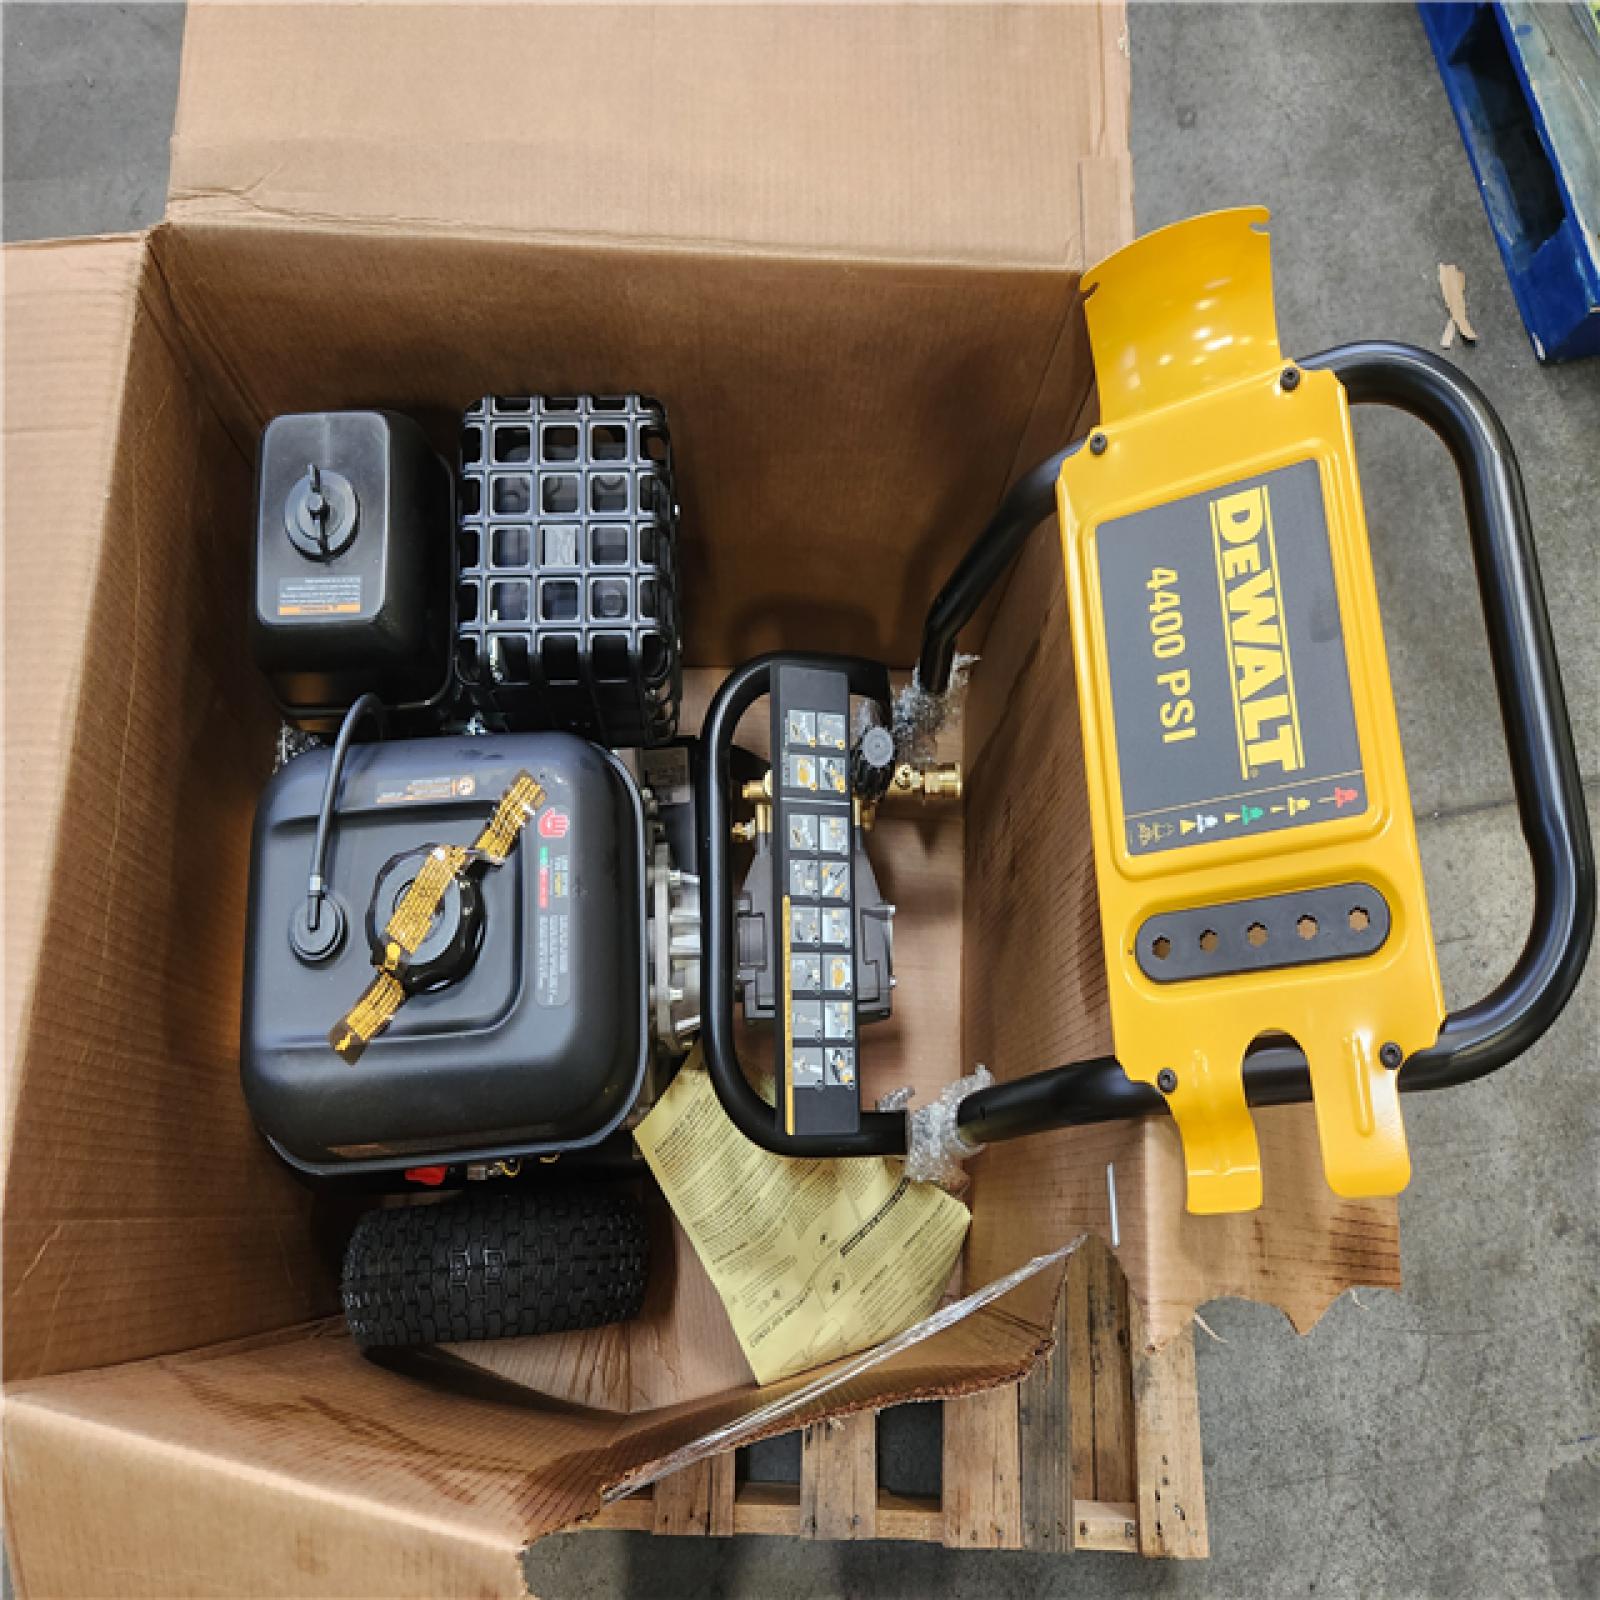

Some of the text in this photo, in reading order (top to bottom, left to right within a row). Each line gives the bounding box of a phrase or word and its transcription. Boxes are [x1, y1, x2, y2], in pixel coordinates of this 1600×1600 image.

[1146, 566, 1197, 743] 4400 PSI
[1215, 486, 1300, 772] DEWALT
